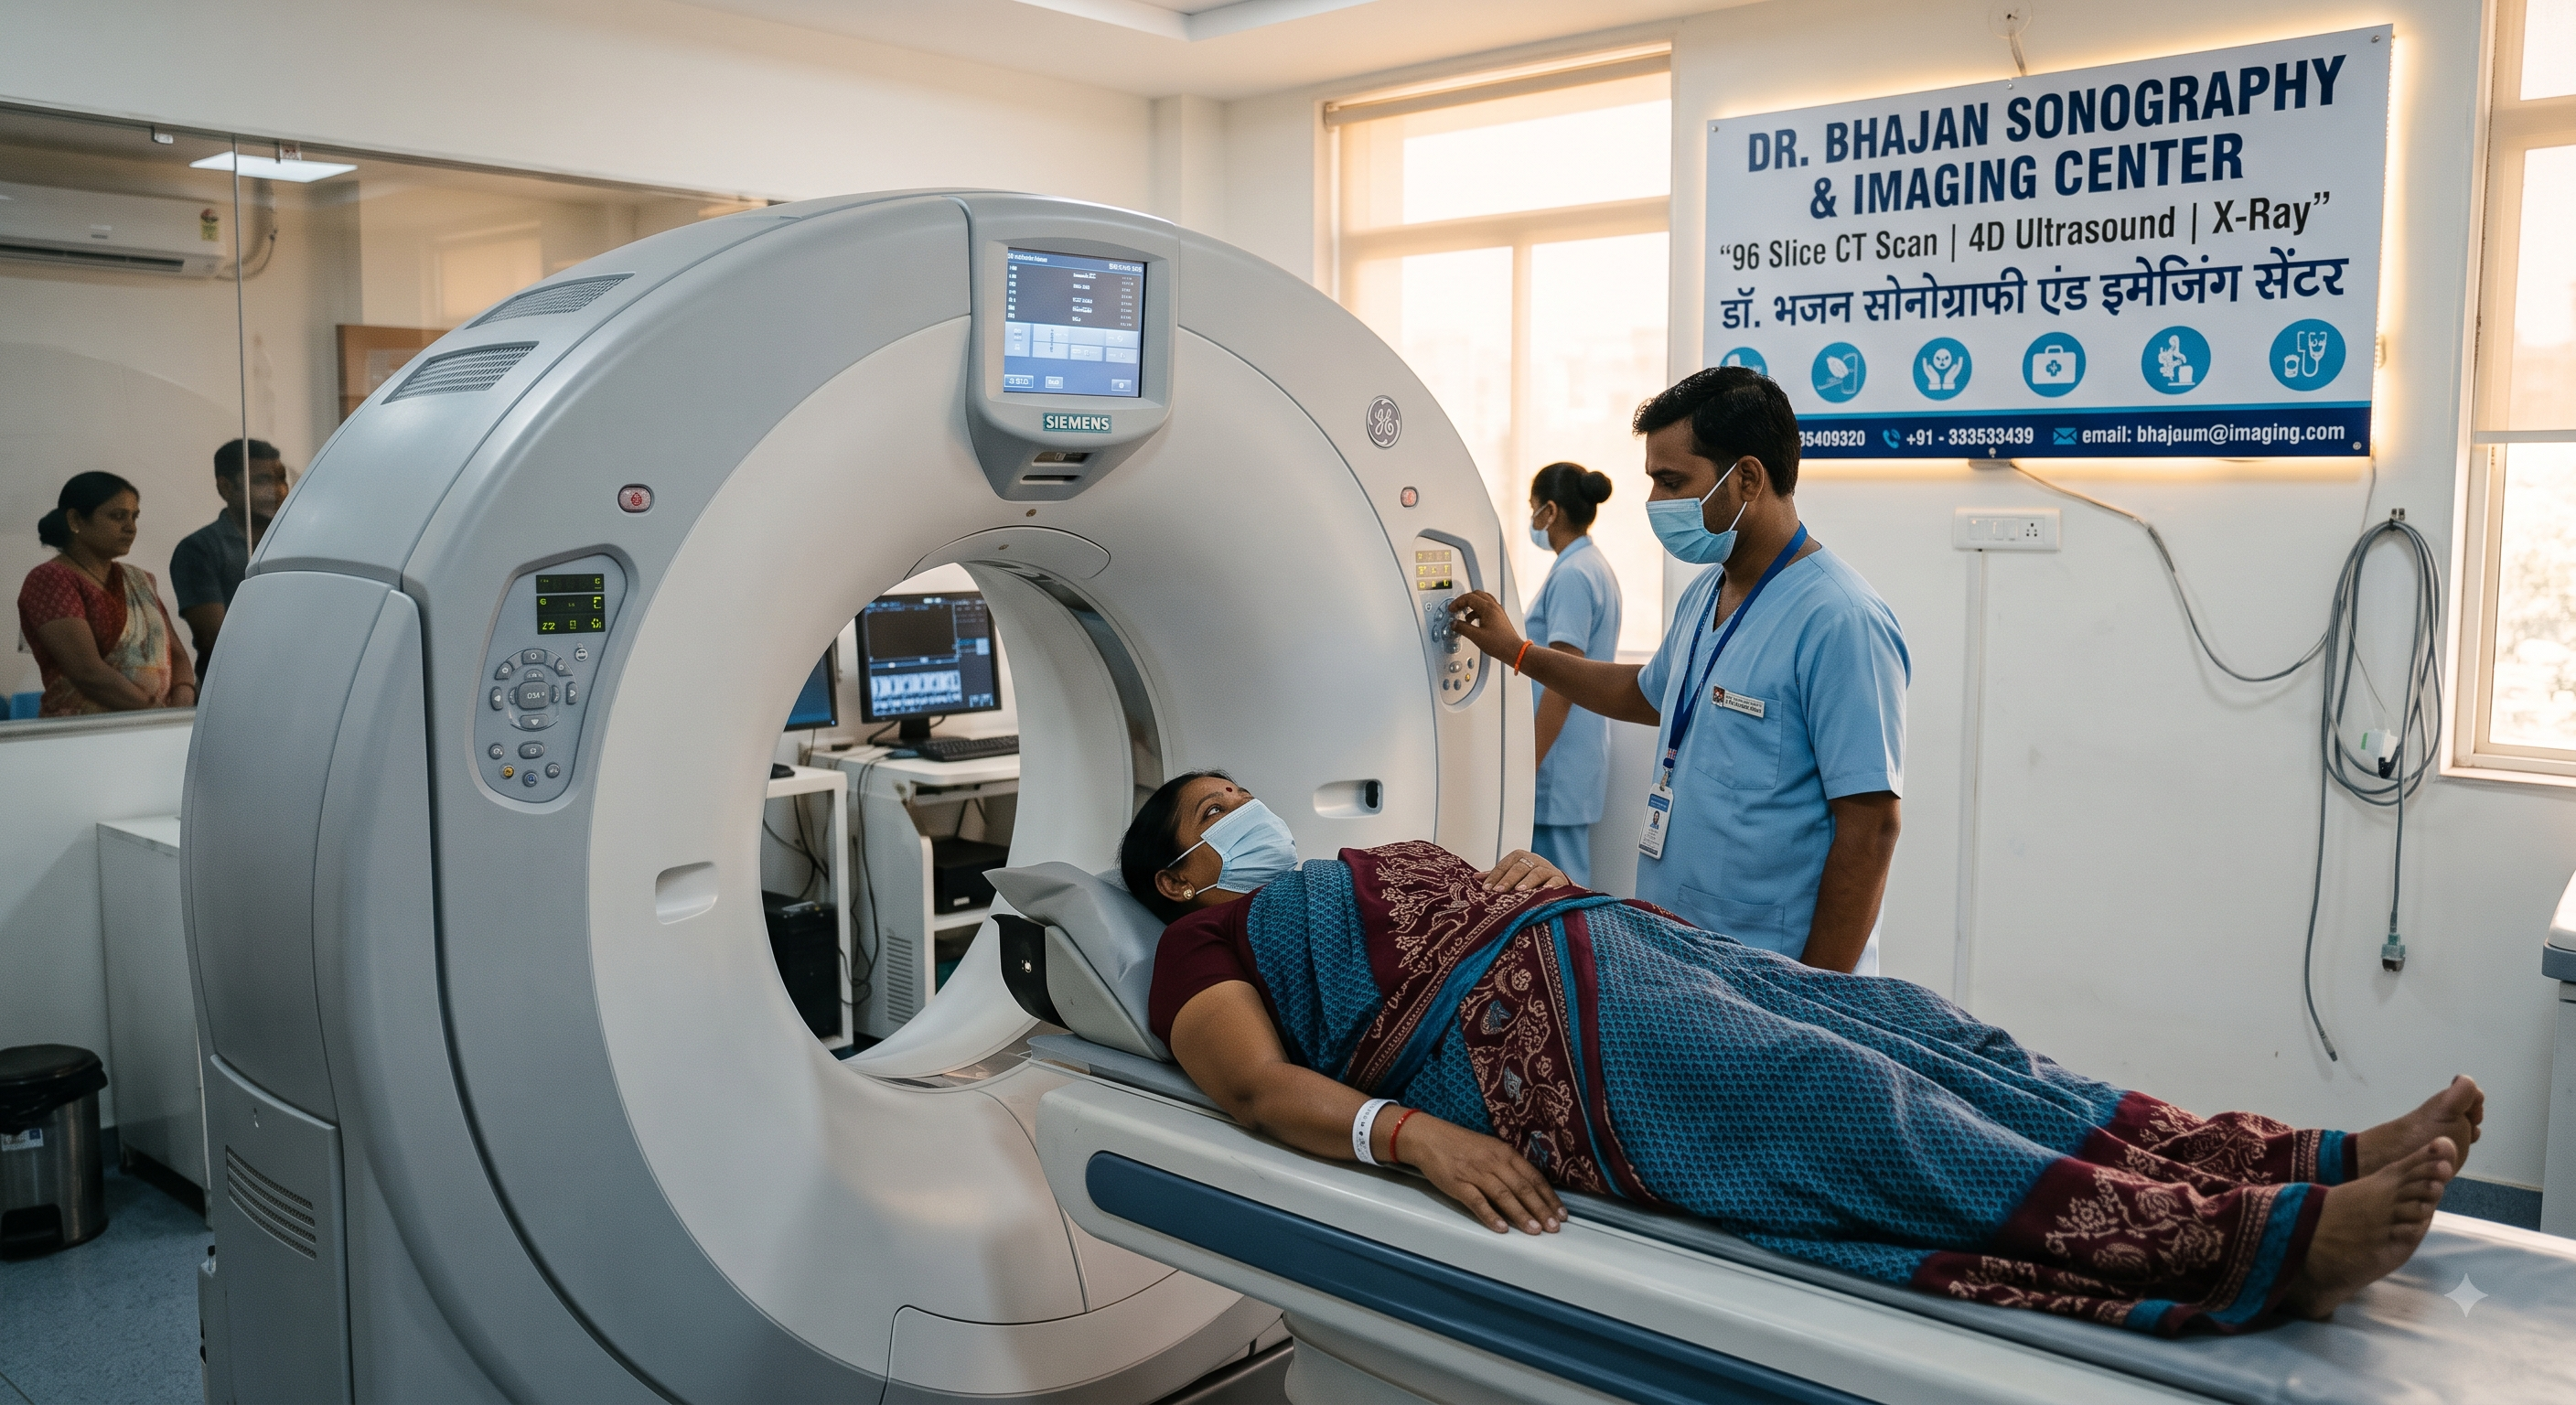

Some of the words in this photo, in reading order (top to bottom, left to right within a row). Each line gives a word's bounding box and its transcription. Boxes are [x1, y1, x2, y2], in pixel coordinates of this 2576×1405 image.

[1748, 128, 1809, 173] DR.
[1826, 102, 1989, 164] BHAJAN
[2006, 54, 2347, 143] SONOGRAPHY
[1809, 177, 1838, 220] &
[1854, 155, 2036, 215] IMAGING
[2055, 133, 2244, 197] CENTER
[1768, 239, 1826, 269] Slice
[1836, 232, 1867, 263] CT
[1875, 230, 1937, 260] Scan
[1969, 220, 2005, 252] 4D
[2016, 205, 2175, 250] Ultrasound
[1720, 286, 1761, 329] डॉ.
[1773, 291, 1854, 327] भजन
[1862, 266, 2028, 322] सोनोग्राफी
[2036, 264, 2091, 316] एंड
[2099, 254, 2243, 316] इमेजिंग
[2253, 246, 2350, 300] सेंटर
[1046, 415, 1110, 430] SIEMENS
[1905, 428, 1933, 446] +91
[1948, 426, 2034, 445] 333533439
[2082, 425, 2132, 444] email:
